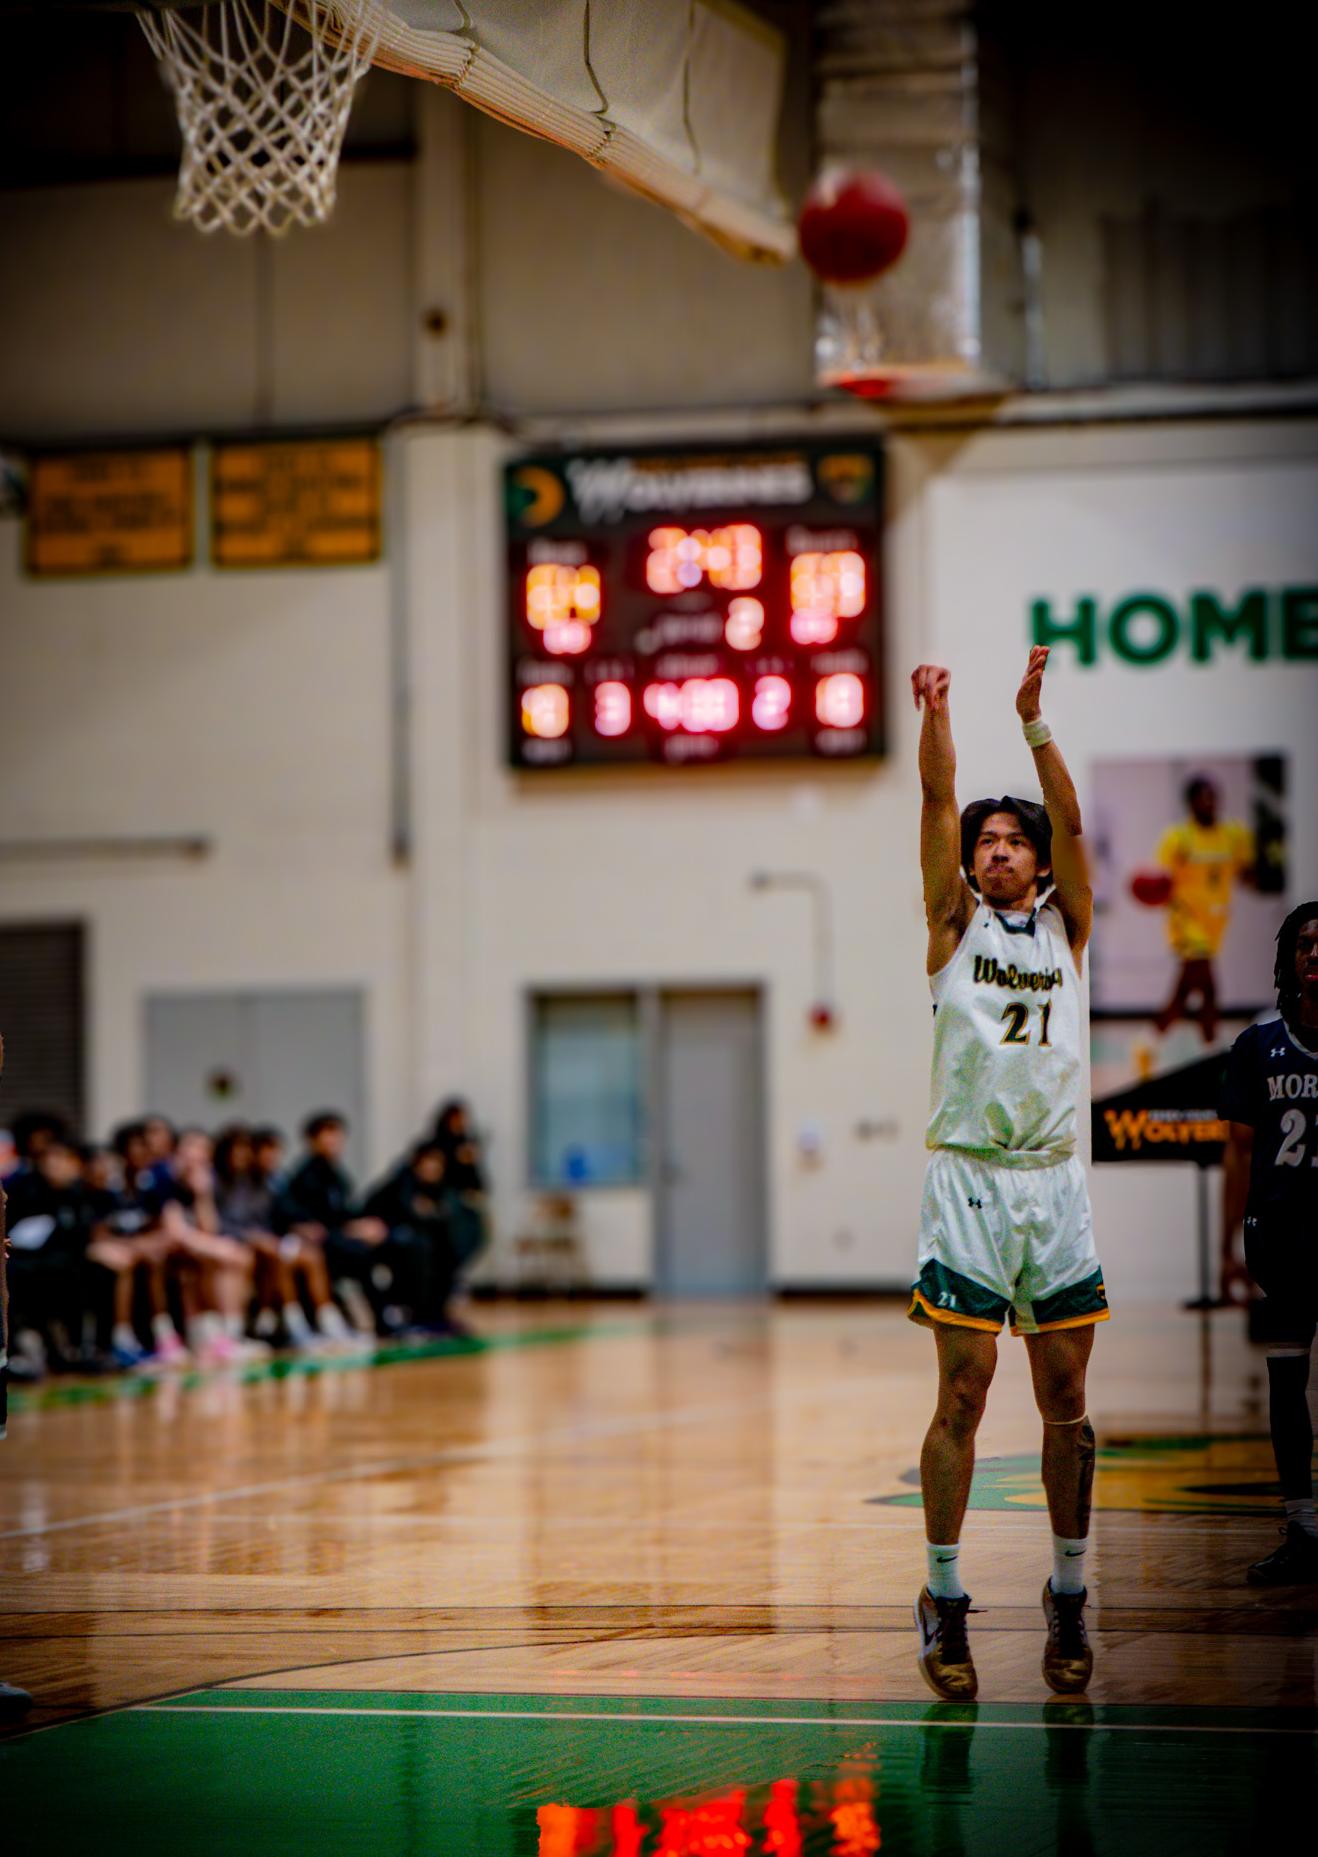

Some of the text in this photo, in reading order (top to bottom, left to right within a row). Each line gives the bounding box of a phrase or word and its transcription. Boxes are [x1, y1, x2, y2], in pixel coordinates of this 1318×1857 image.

[1031, 586, 1318, 667] HOME
[999, 999, 1052, 1047] 21
[1267, 1073, 1318, 1100] MOR
[1274, 1108, 1318, 1167] 2
